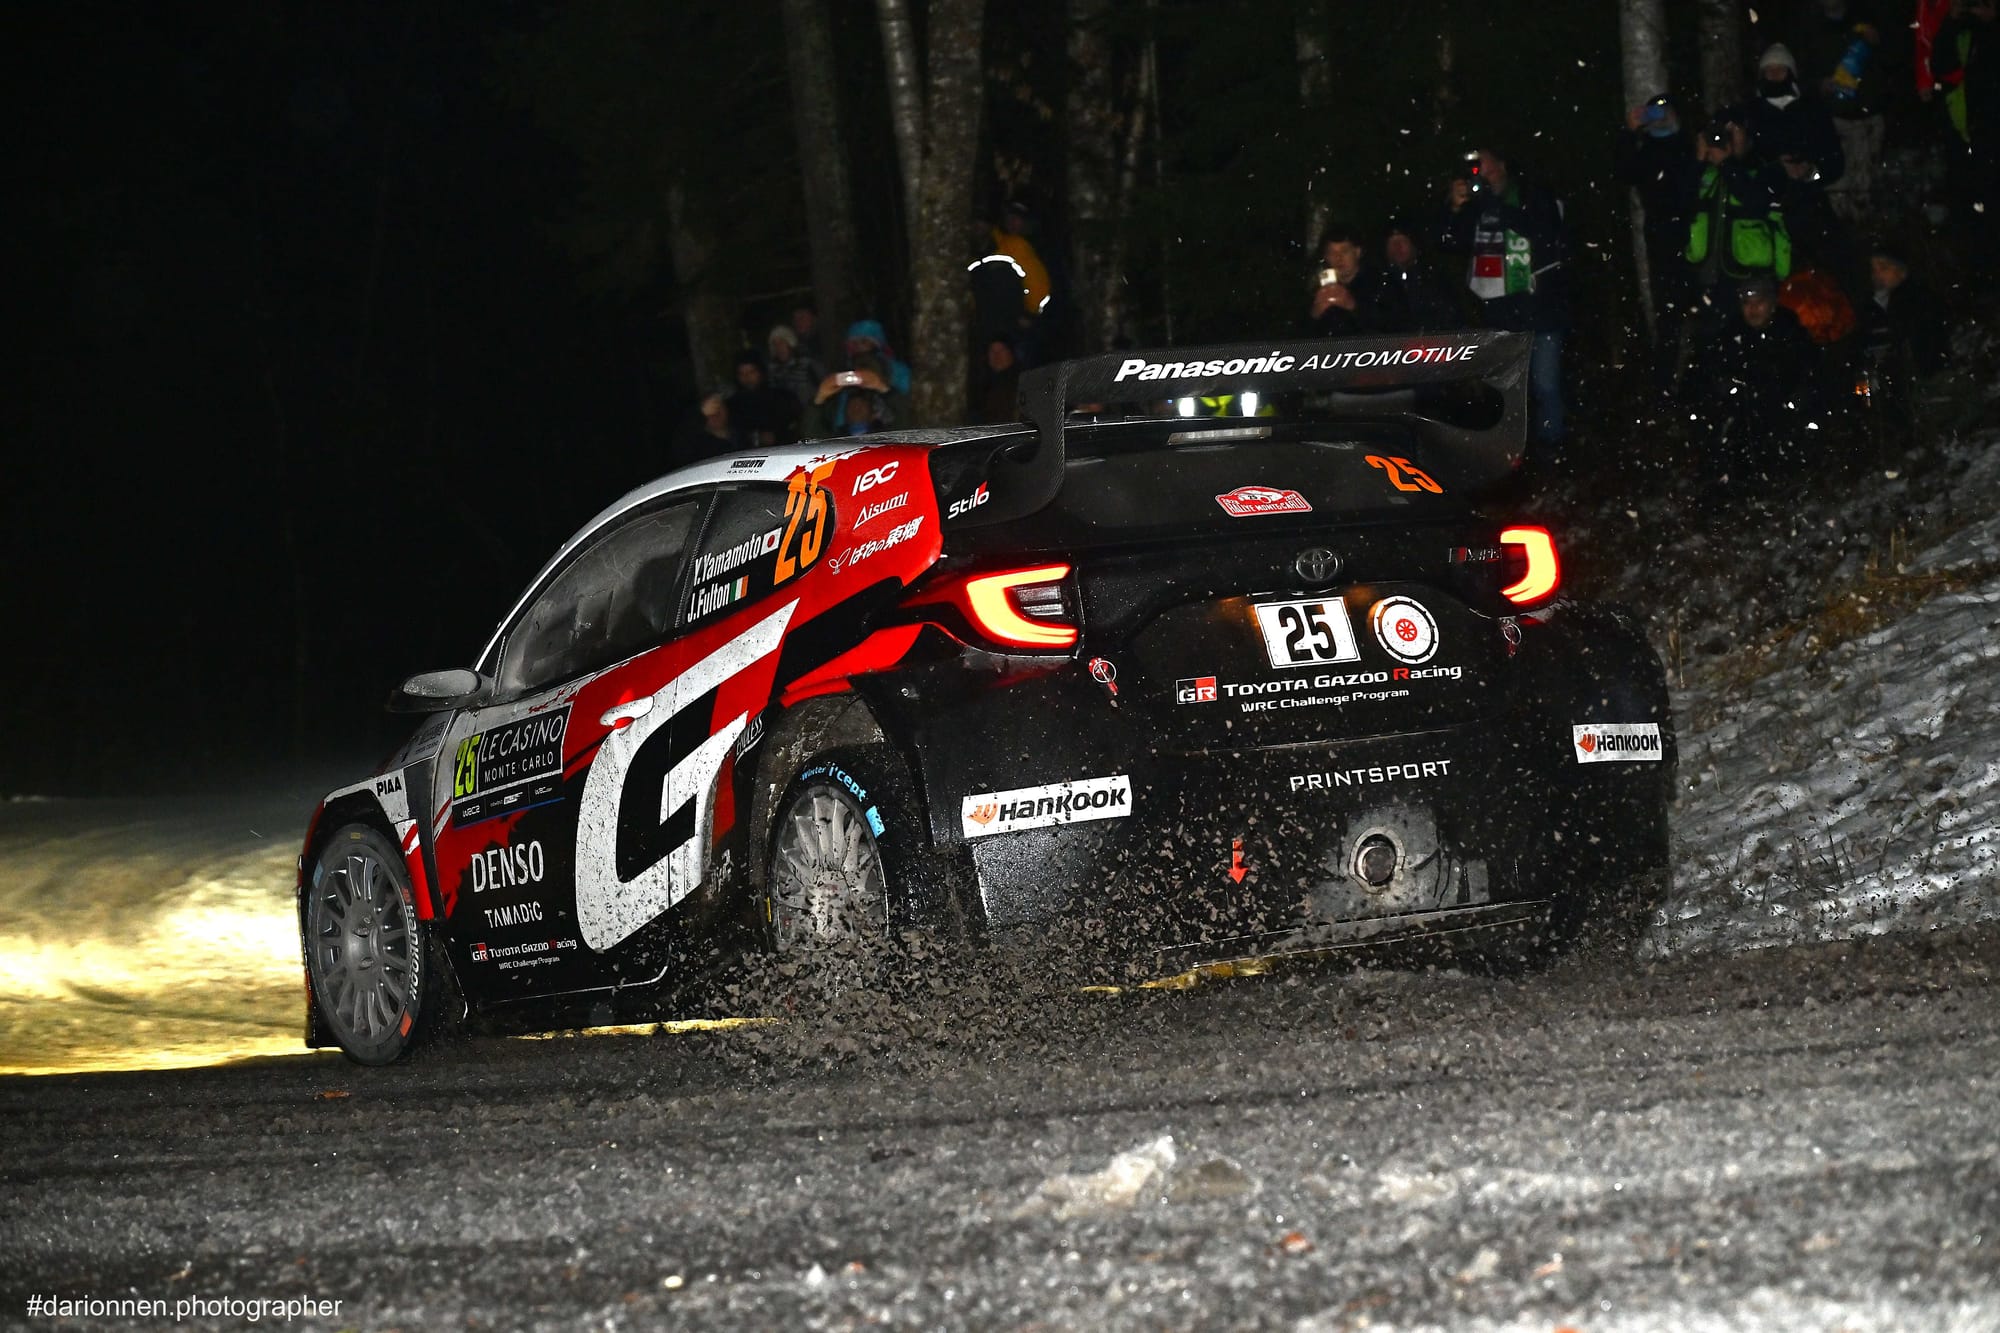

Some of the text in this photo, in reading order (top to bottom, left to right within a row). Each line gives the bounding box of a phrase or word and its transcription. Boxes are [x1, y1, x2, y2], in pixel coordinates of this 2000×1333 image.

[1113, 345, 1479, 382] Panasonic AUTOMOTIVE
[1365, 455, 1443, 494] 25
[774, 459, 837, 586] 25
[853, 491, 909, 530] Aisumi
[693, 533, 762, 587] Y.Yamamoto
[687, 582, 731, 623] J.Fulton
[1278, 605, 1338, 660] 25
[1178, 664, 1462, 703] GR TOYOTA GAZOO Racing
[1240, 688, 1410, 713] WRC Challenge Program
[455, 735, 481, 797] 25
[481, 733, 500, 763] LE
[500, 715, 564, 757] CASINO
[376, 776, 402, 797] PIAA
[1289, 760, 1451, 792] PRINTSPORT
[471, 840, 544, 893] DENSO
[472, 937, 577, 961] GR TOYOTA GAZOO Racing
[513, 959, 537, 968] Challenge
